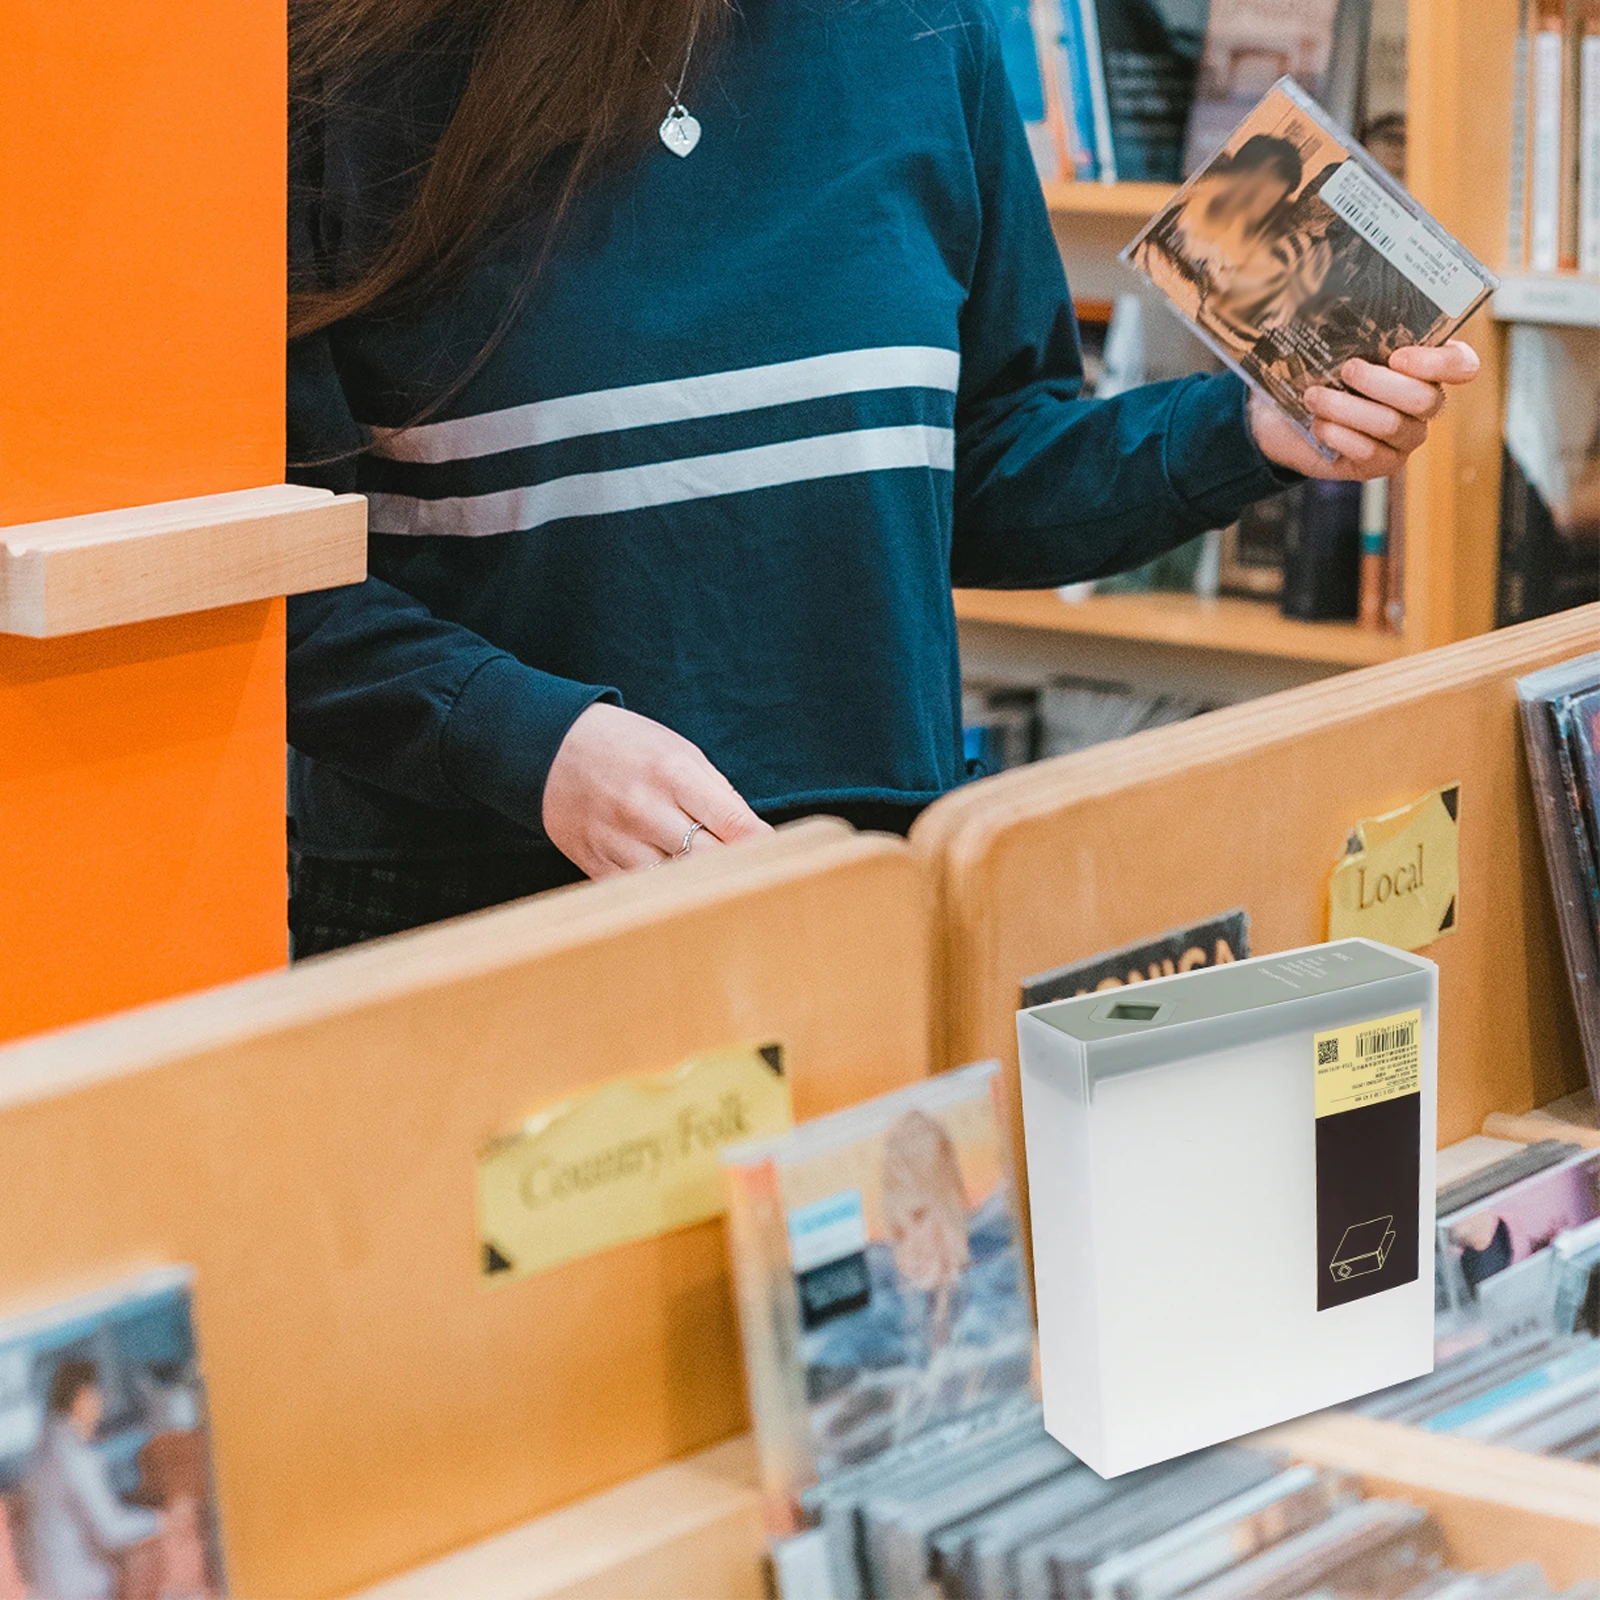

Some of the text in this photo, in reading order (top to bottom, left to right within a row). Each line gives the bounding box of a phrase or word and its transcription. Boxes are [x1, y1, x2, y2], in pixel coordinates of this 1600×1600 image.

[674, 124, 689, 144] A
[1357, 842, 1424, 910] Local
[518, 1088, 749, 1210] Country Folk
